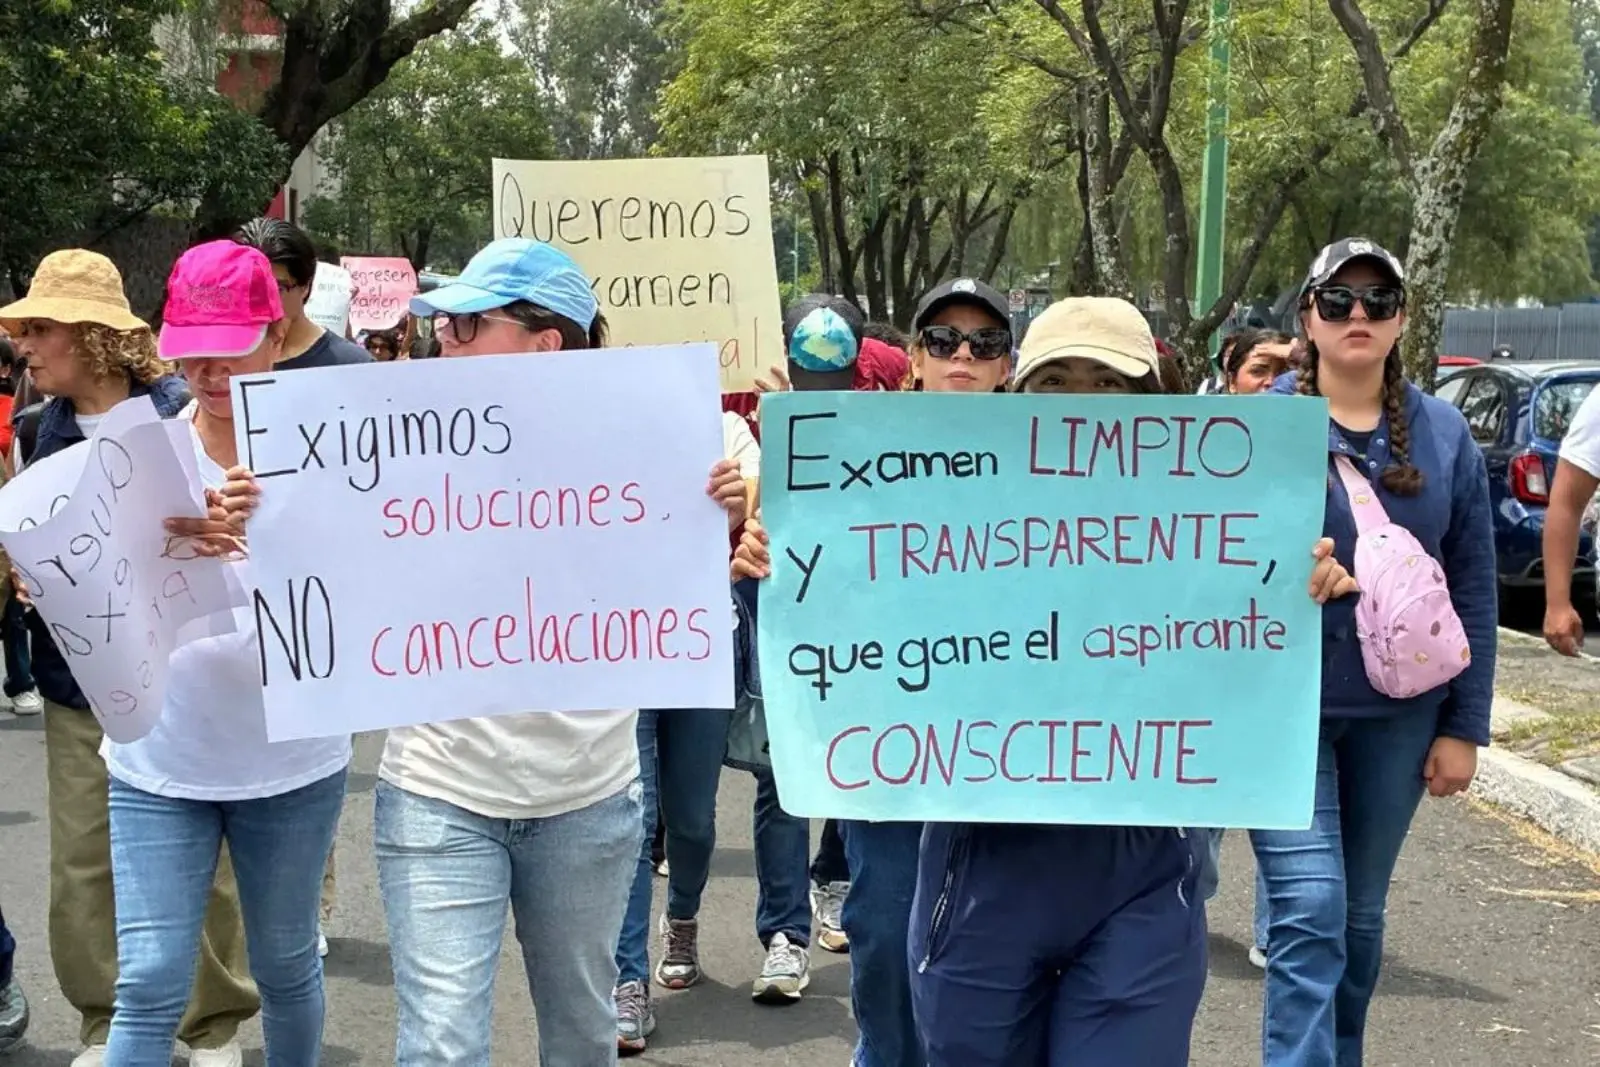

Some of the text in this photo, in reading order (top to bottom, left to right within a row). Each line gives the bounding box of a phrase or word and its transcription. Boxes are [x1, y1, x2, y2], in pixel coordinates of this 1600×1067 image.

[500, 172, 751, 244] Queremos
[239, 378, 512, 492] Exigimos
[787, 411, 1253, 491] Examen LIMPIO
[849, 513, 1277, 585] TRANSPARENTE,
[252, 575, 710, 686] NO cancelaciones
[788, 597, 1287, 702] que gane el aspirante
[826, 719, 1218, 790] CONSCIENTE
